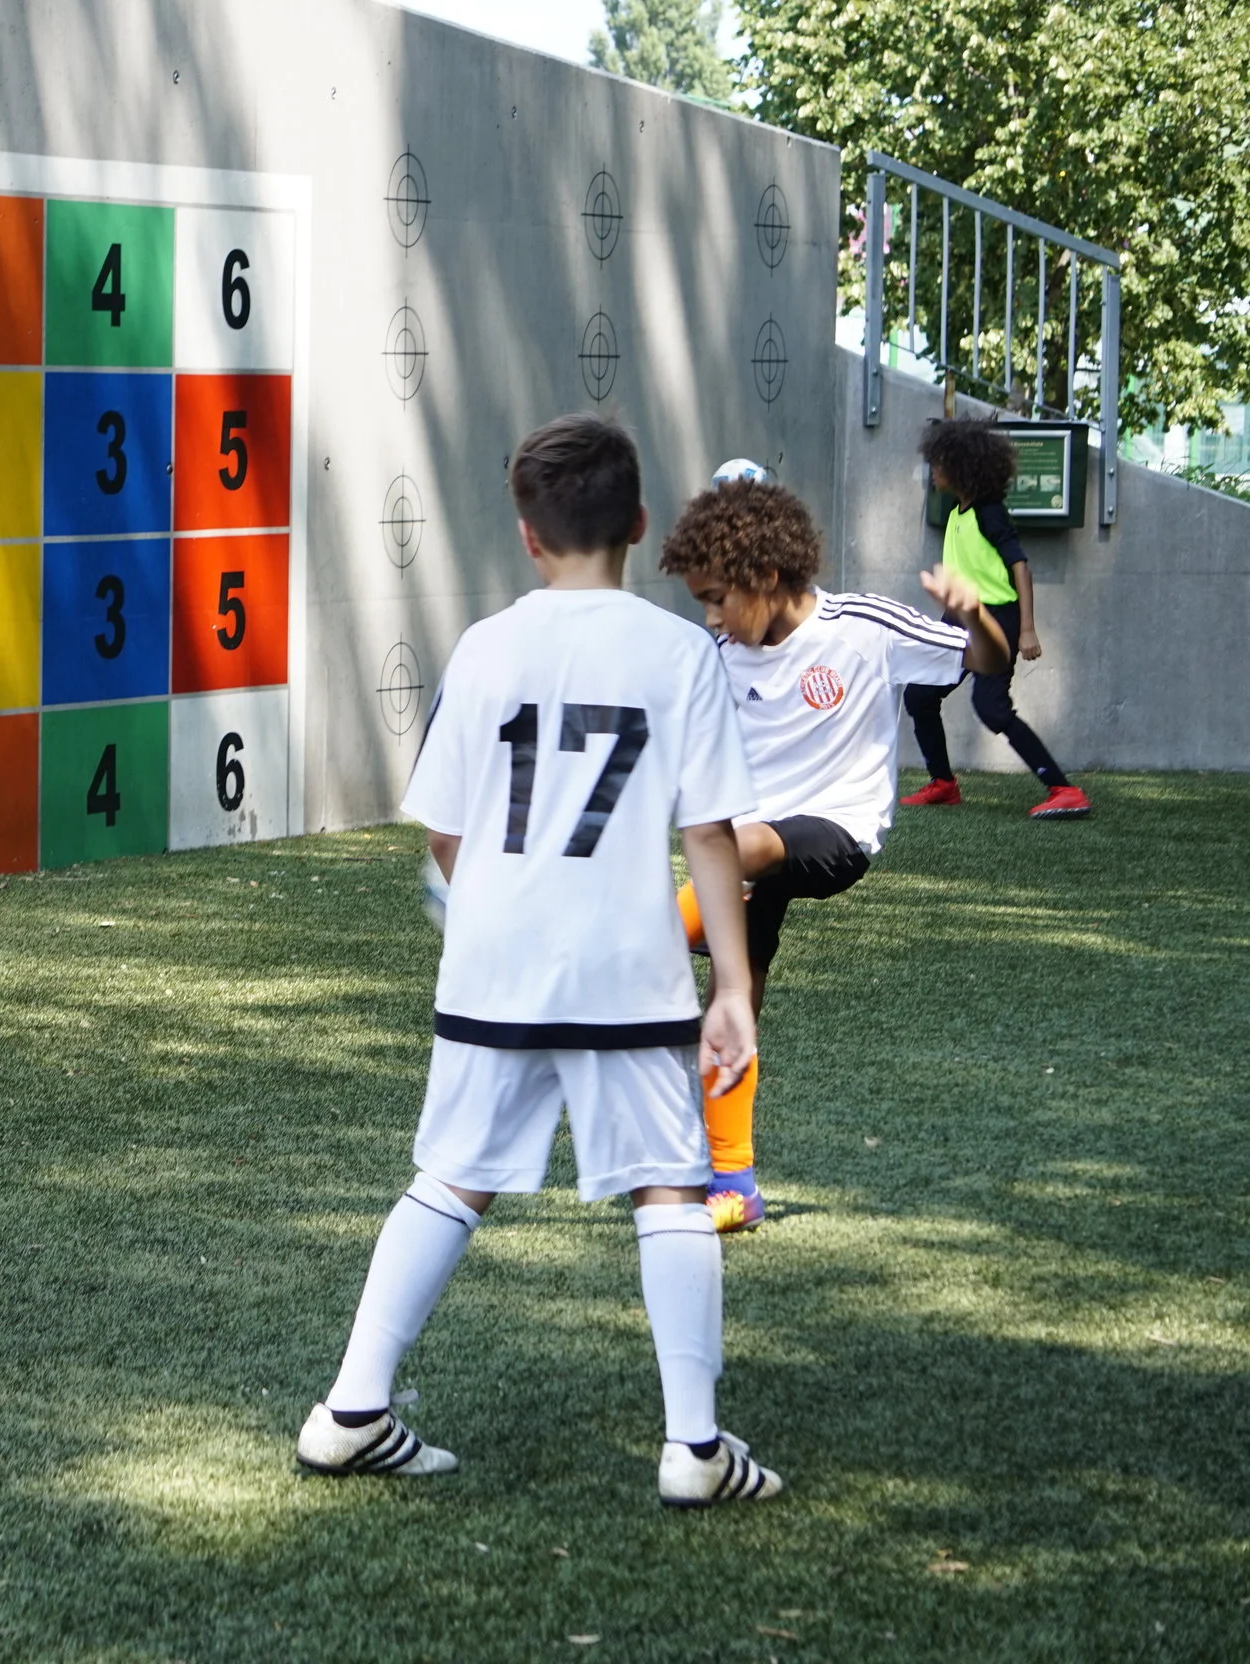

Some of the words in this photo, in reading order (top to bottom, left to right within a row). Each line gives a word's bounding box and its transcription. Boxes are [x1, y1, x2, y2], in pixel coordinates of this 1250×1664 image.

[91, 243, 126, 327] 4
[221, 249, 251, 330] 6
[95, 410, 127, 495] 3
[218, 410, 248, 491] 5
[94, 575, 126, 660] 3
[217, 571, 246, 651] 5
[86, 743, 121, 828] 4
[216, 731, 245, 812] 6
[498, 702, 652, 858] 17
